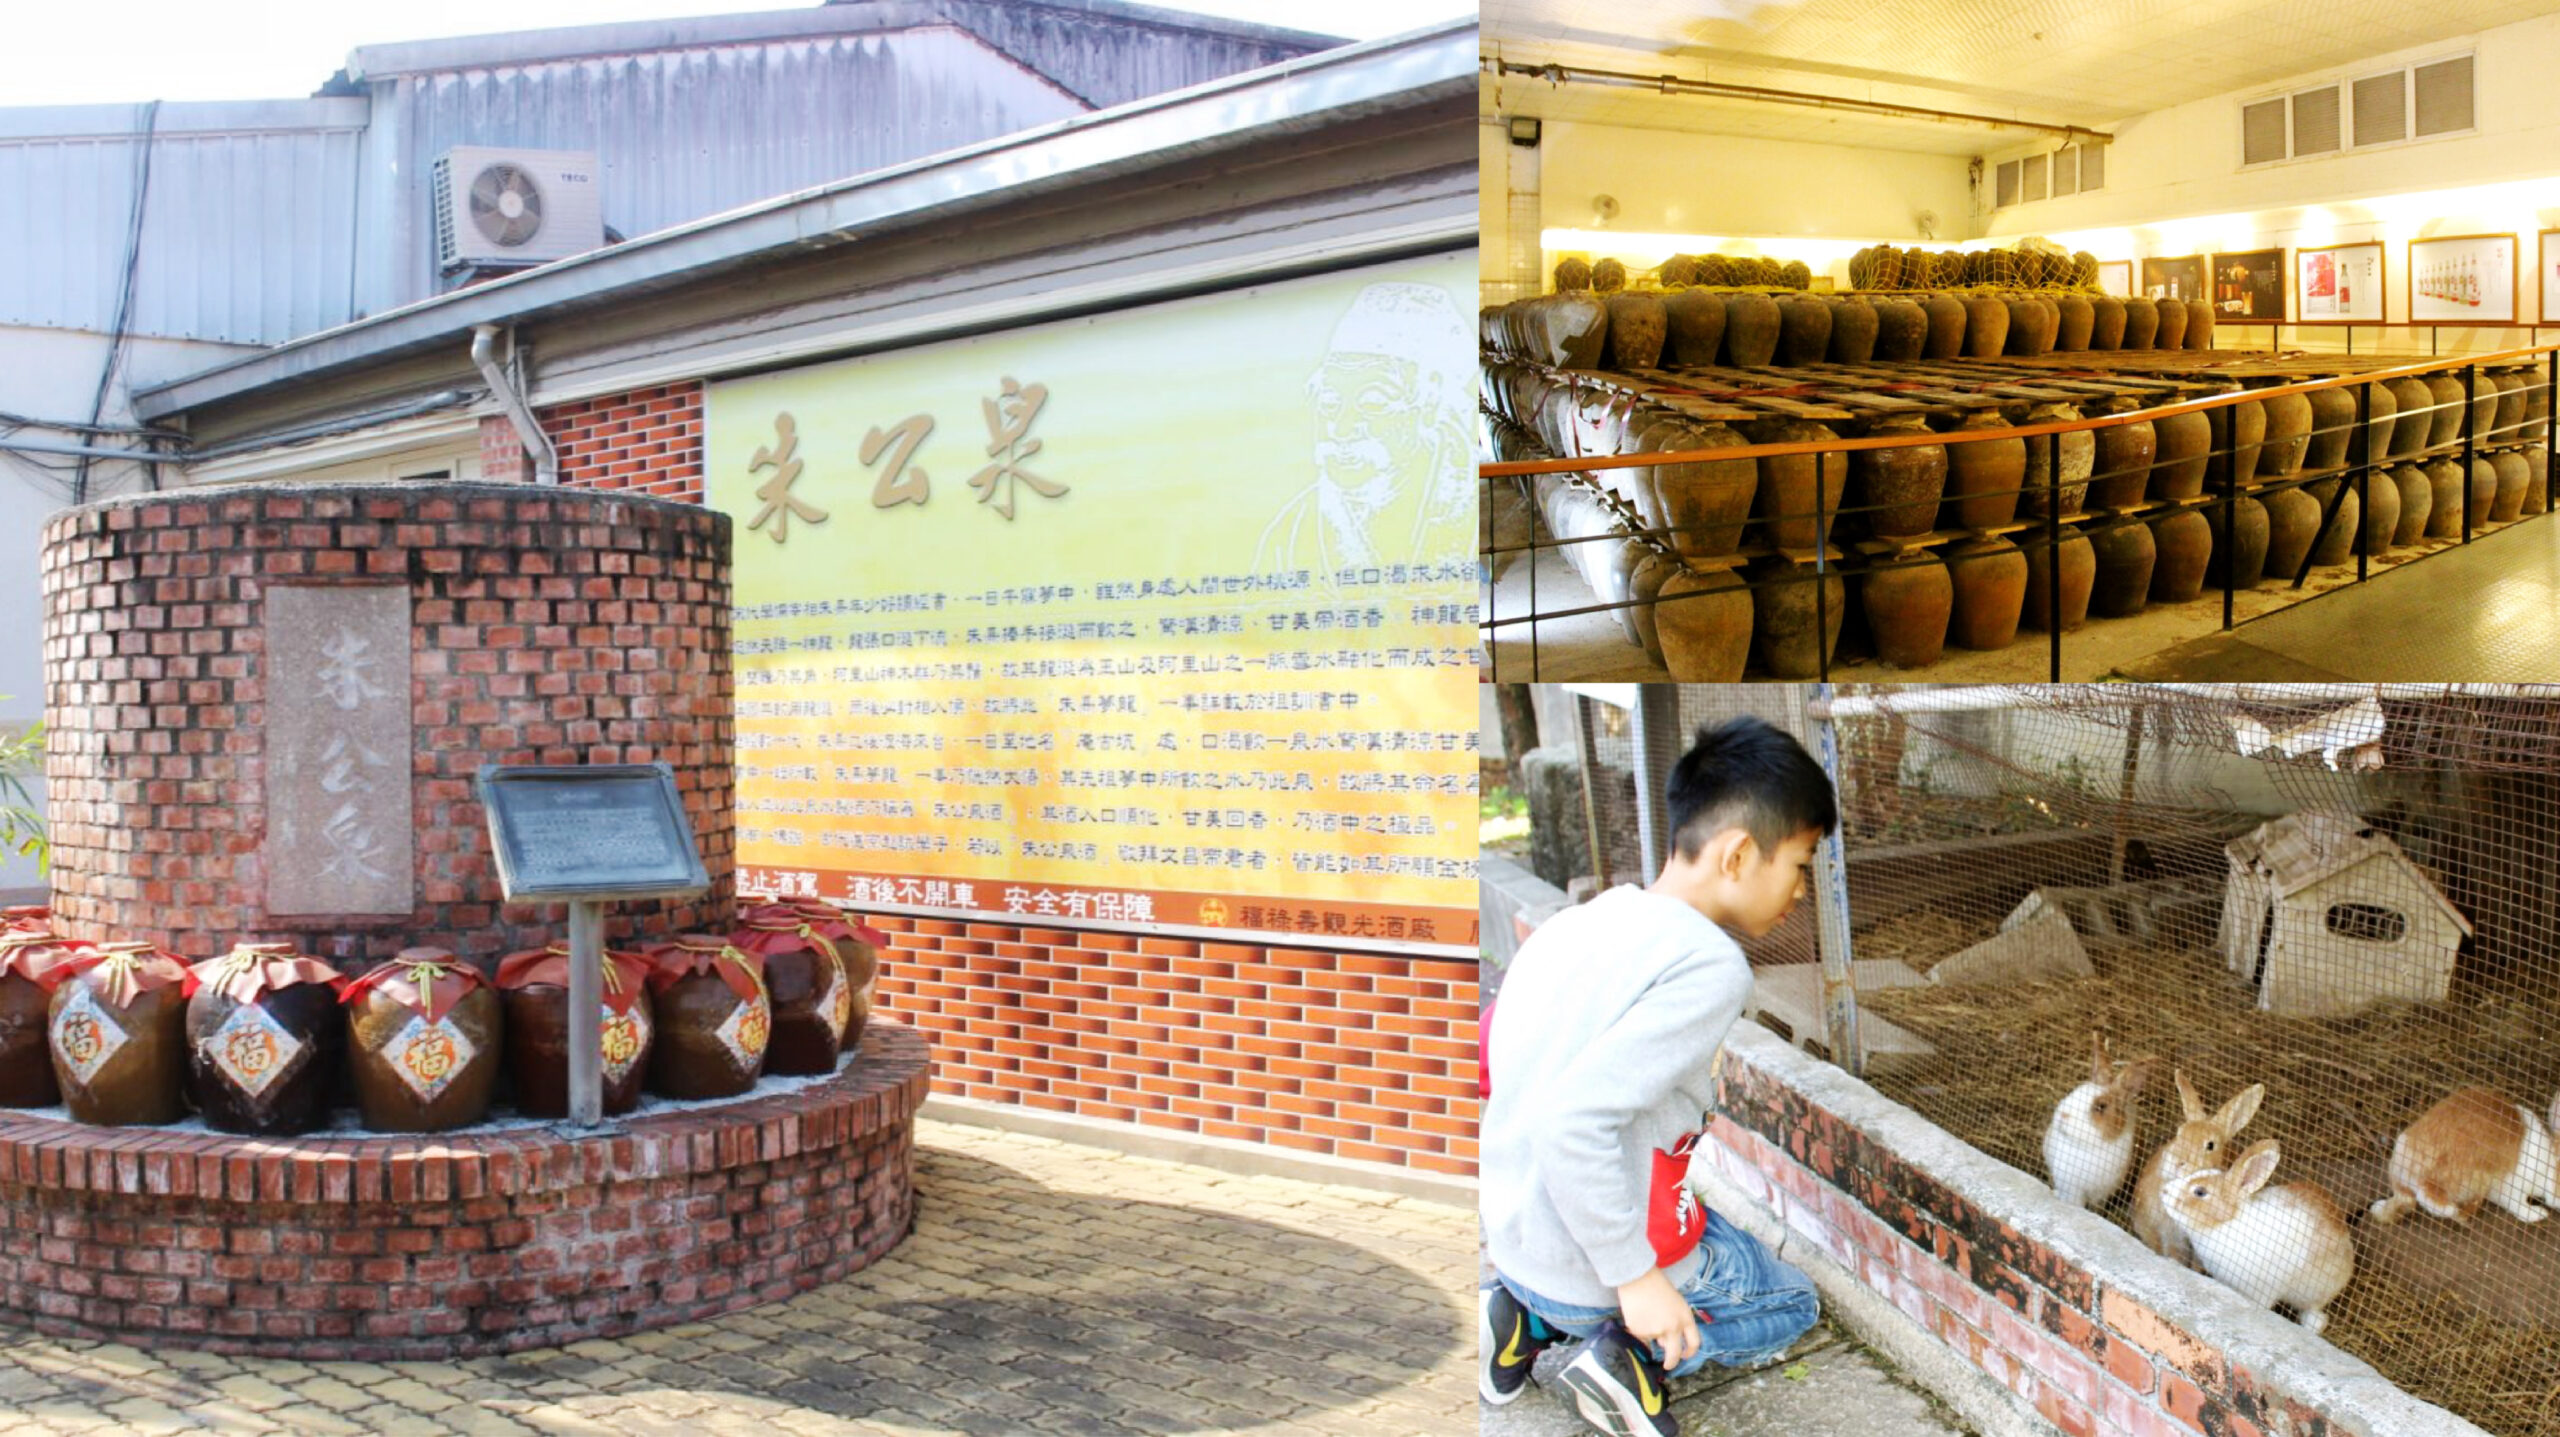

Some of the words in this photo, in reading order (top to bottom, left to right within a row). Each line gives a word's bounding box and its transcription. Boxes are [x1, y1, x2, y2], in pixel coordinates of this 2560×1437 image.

[747, 376, 1071, 544] 朱公泉
[314, 624, 389, 882] 朱公泉
[847, 874, 979, 909] 酒後不開車
[1003, 886, 1155, 922] 安全有保障
[1239, 905, 1436, 940] 福祿壽觀光酒廠
[62, 1012, 99, 1060] 福
[229, 1027, 272, 1070] 福
[407, 1027, 454, 1072] 福
